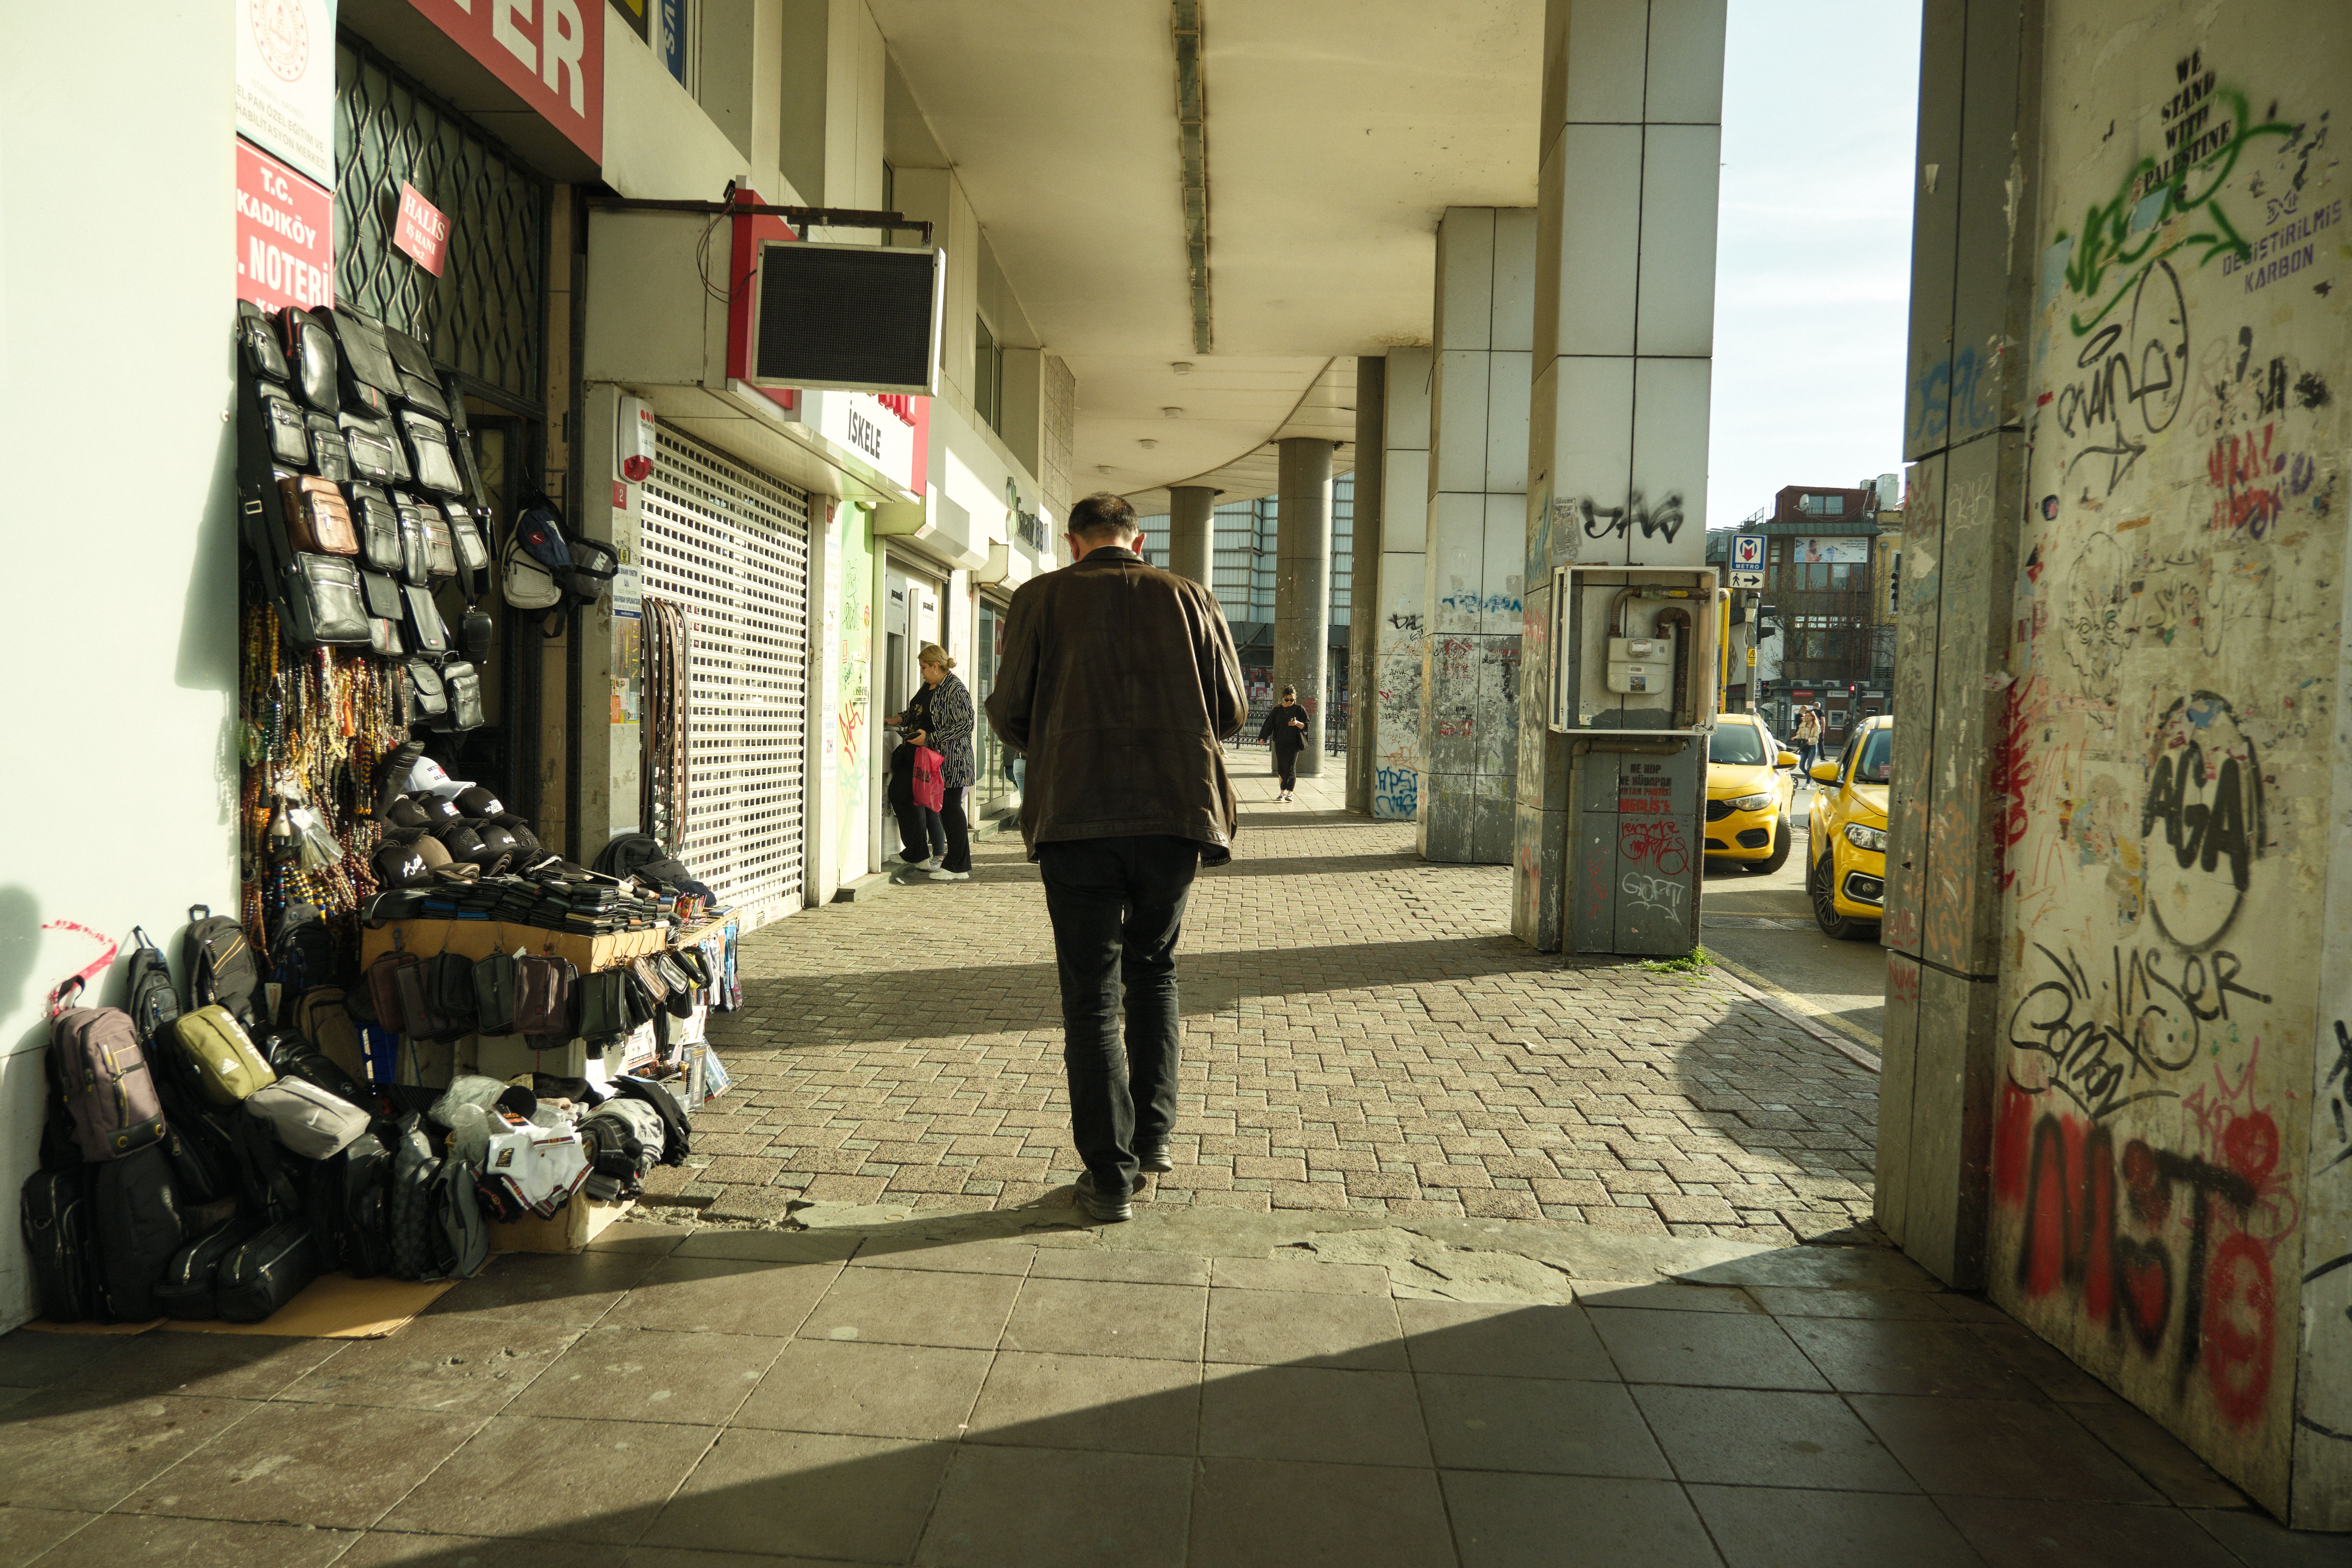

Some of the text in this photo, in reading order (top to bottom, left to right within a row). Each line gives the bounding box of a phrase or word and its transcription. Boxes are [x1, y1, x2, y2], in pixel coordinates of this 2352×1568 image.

[2161, 68, 2216, 125] STAND
[248, 92, 265, 112] PAN
[267, 103, 286, 127] ÖZEL
[288, 120, 313, 144] EĞİTİM
[315, 138, 324, 152] VE
[2165, 104, 2210, 151] WITH
[296, 143, 327, 171] MERKEZİ
[2145, 119, 2231, 190] PALESTINE
[261, 167, 292, 205] T.C.
[237, 189, 316, 250] KADIKÖY
[404, 193, 444, 241] HALİS
[406, 220, 436, 255] İŞ HANI
[250, 236, 329, 309] NOTERİ
[412, 243, 425, 260] No:2
[2243, 244, 2314, 294] KARBON
[848, 400, 881, 460] İSKELE
